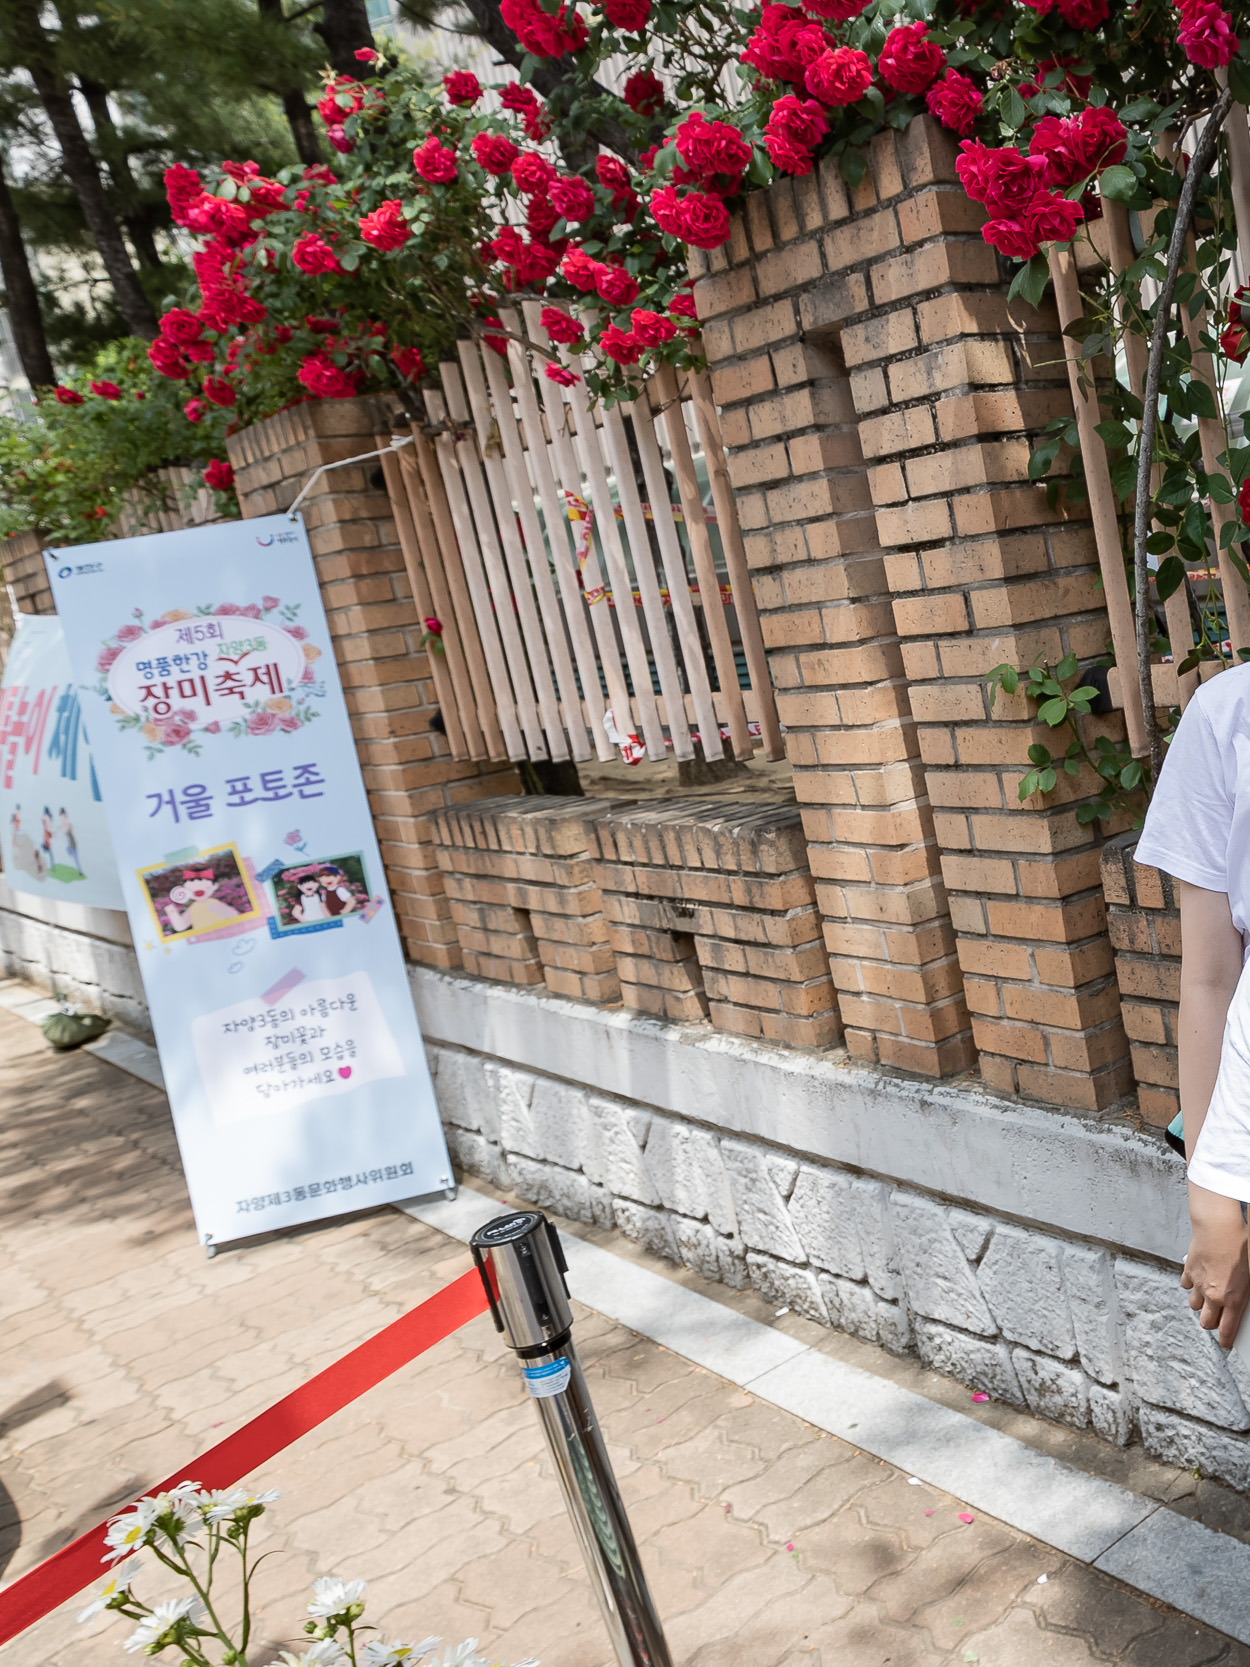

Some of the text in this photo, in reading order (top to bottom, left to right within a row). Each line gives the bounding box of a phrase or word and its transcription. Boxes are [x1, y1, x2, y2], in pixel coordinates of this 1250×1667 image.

[174, 621, 225, 645] 제5회
[216, 636, 268, 656] 자양3동
[136, 651, 209, 680] 명품한강
[138, 662, 284, 716] 장미축제
[146, 763, 325, 823] 거울 포토존
[222, 993, 357, 1034] 자양3동의 아름다운
[264, 1026, 326, 1049] 장미꽃과
[243, 1039, 357, 1075] 여러분들의 모습을
[256, 1069, 335, 1098] 담아가세요
[235, 1161, 415, 1214] 자양제3동문화행사위원회
